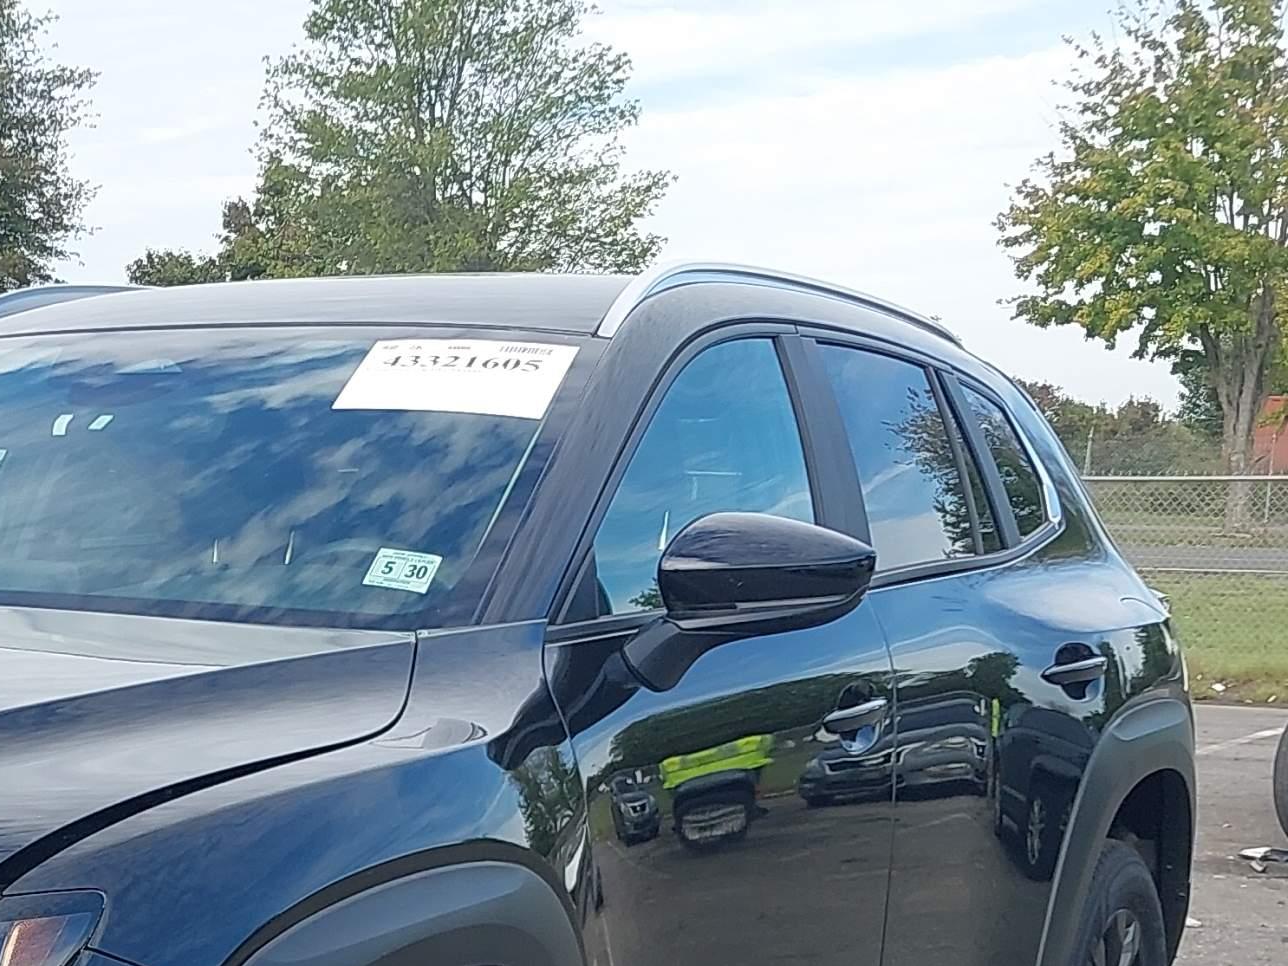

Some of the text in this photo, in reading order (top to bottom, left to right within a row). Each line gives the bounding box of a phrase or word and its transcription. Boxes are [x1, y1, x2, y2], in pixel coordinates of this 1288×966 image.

[383, 355, 543, 372] 43321605
[380, 561, 429, 580] 5 30
